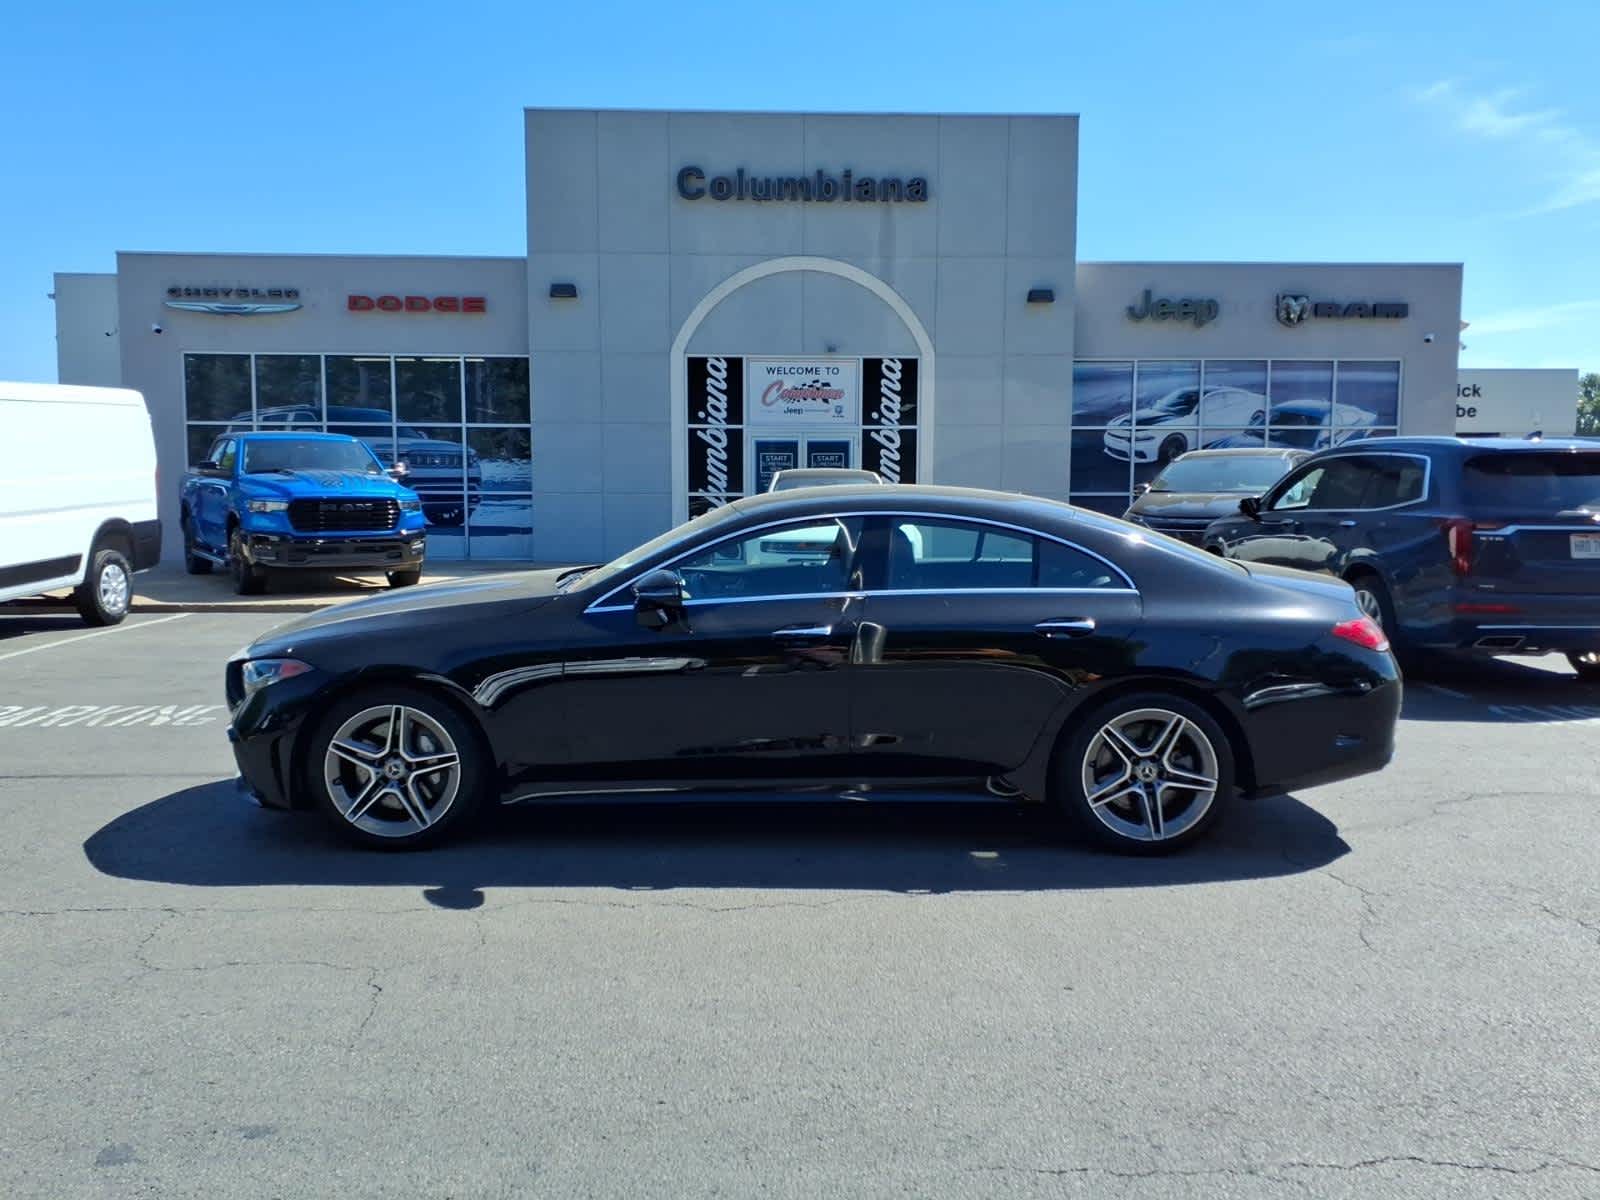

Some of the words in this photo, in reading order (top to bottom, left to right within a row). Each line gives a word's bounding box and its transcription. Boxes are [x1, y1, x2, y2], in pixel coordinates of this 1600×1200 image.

[676, 166, 928, 201] Columbiana
[167, 287, 300, 298] CHRYSLER
[348, 295, 486, 312] DODGE
[1127, 289, 1219, 327] Jeep
[1314, 302, 1409, 318] RAM
[766, 366, 821, 376] WELCOME
[826, 366, 840, 376] TO
[1456, 383, 1481, 398] ick
[1456, 404, 1477, 418] be
[692, 356, 728, 518] lumbiana
